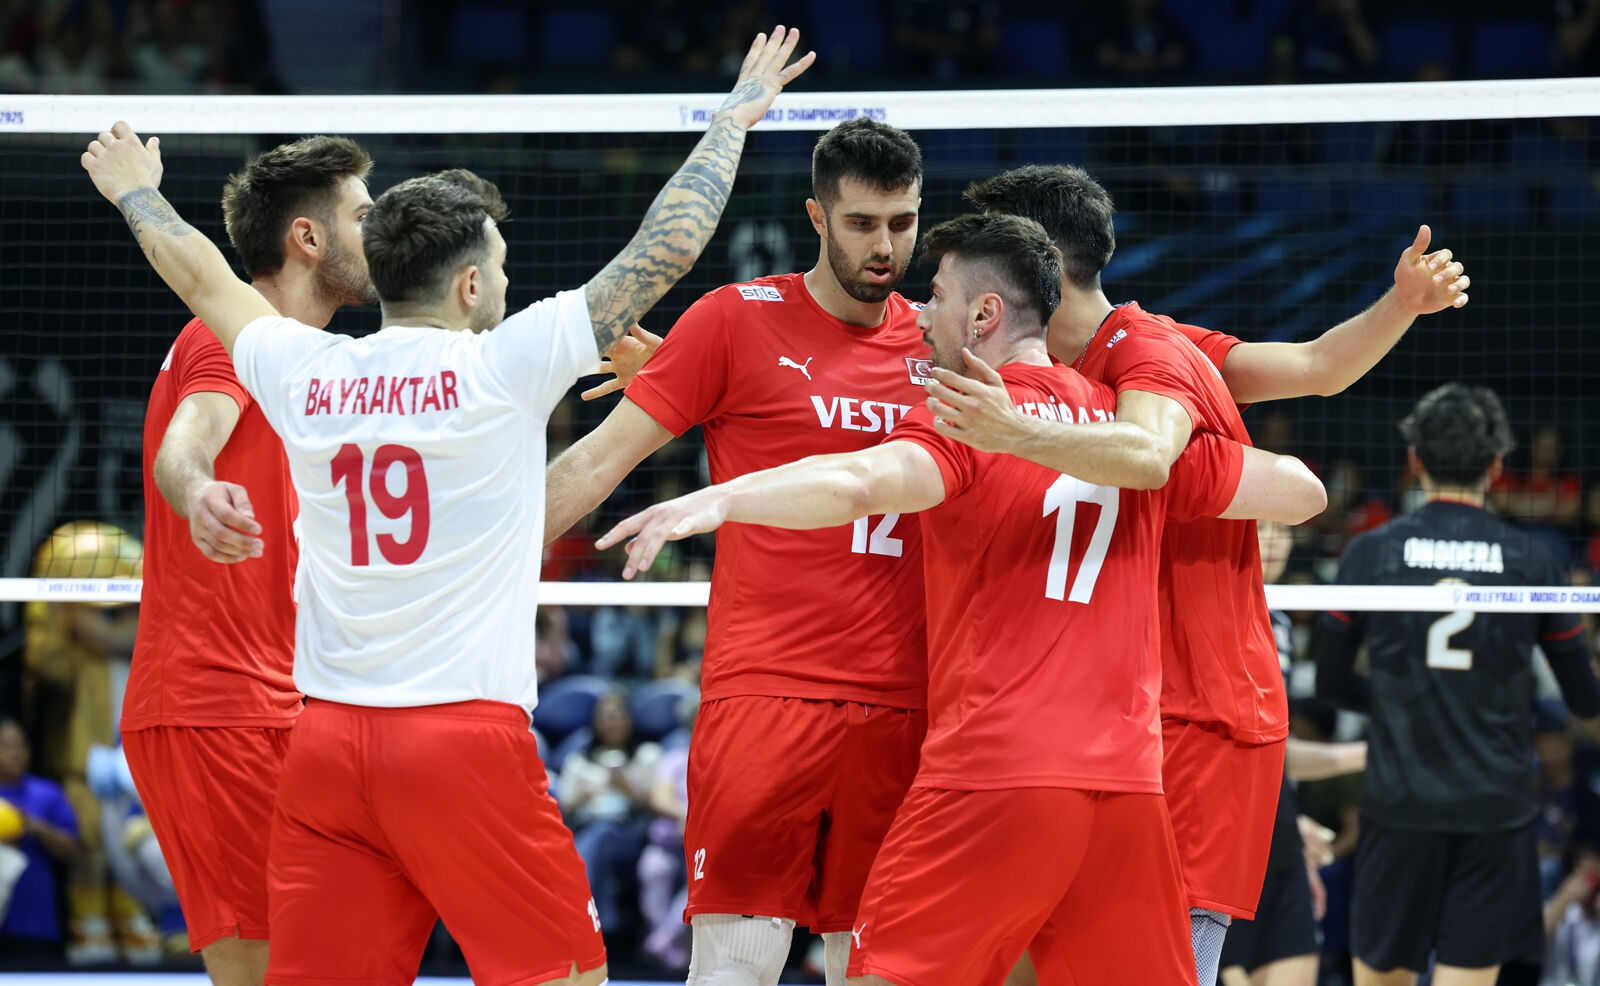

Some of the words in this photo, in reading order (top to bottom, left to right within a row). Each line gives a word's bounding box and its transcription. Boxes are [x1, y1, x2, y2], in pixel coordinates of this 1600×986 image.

[787, 107, 858, 122] CHAMPIONSHIP
[305, 370, 459, 416] BAYRAKTAR
[810, 395, 913, 435] VEST
[330, 443, 431, 566] 19
[1042, 473, 1120, 605] 17
[1403, 537, 1504, 573] ONODERA
[1465, 591, 1523, 603] VOLLEYBALL
[1529, 591, 1567, 603] WORLD
[1426, 577, 1475, 671] 2
[694, 848, 706, 881] 12
